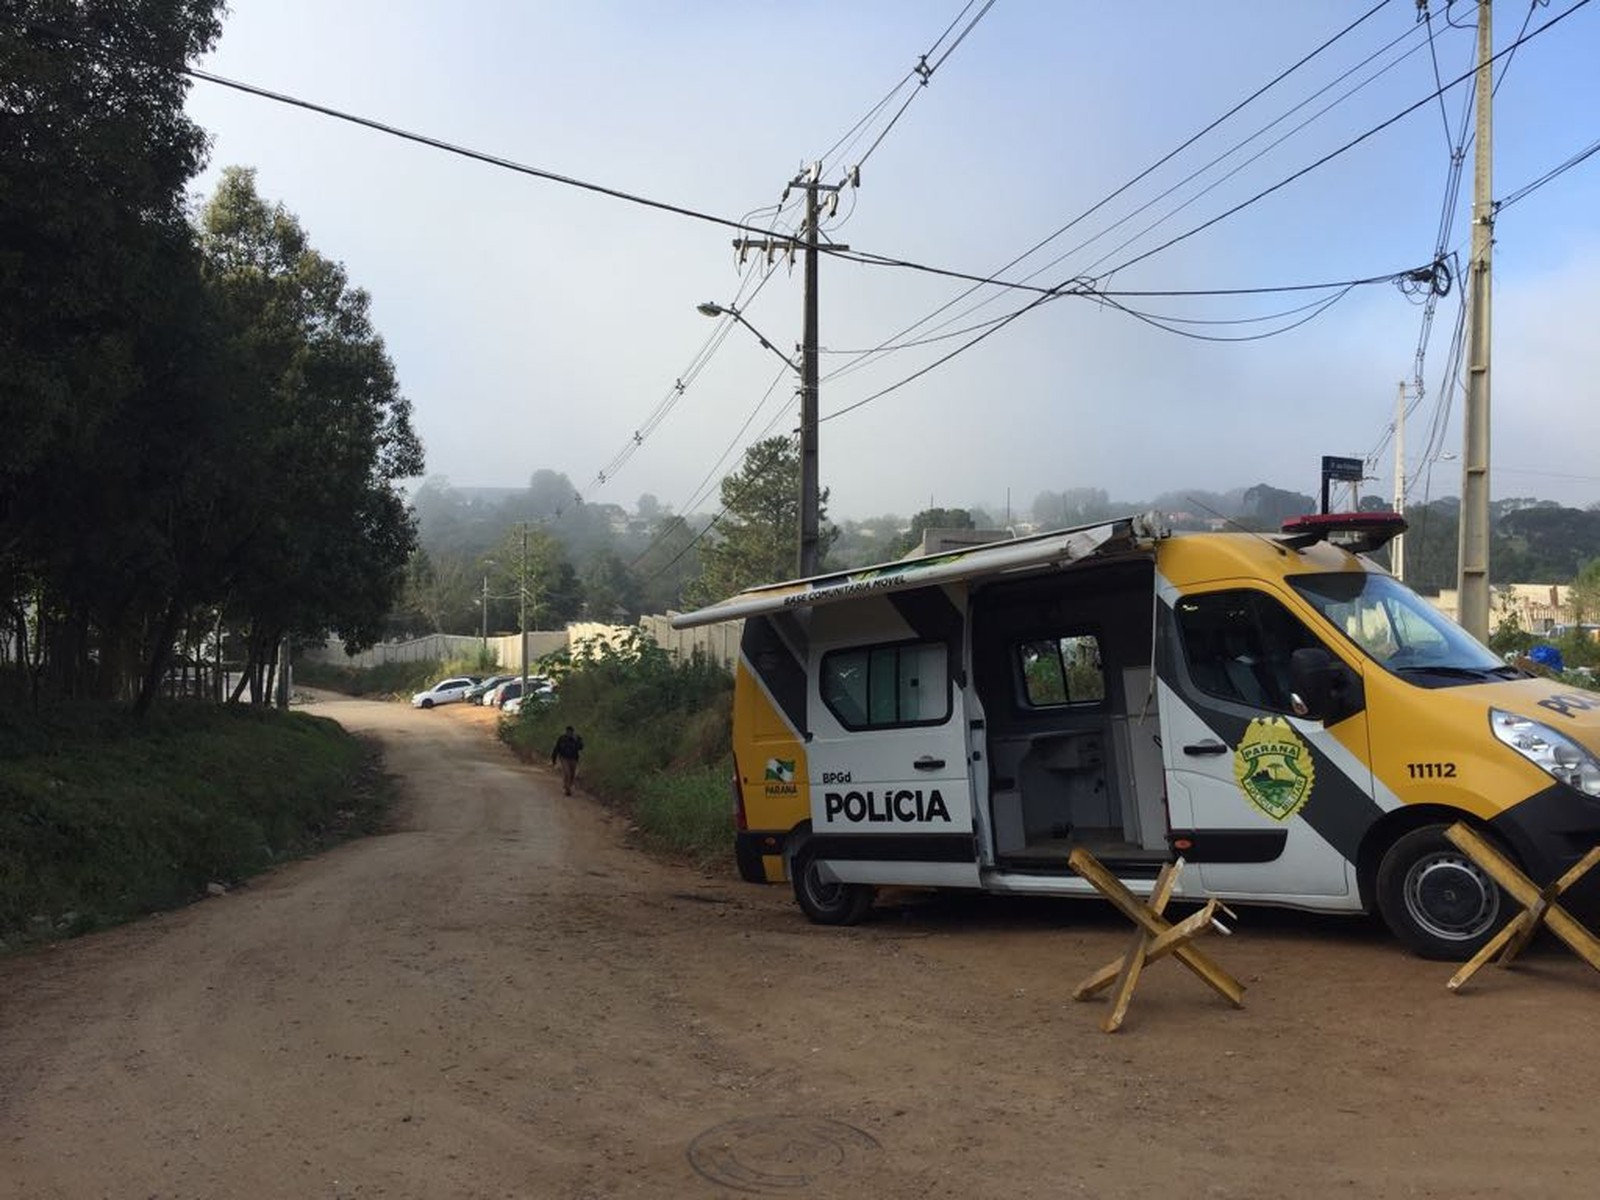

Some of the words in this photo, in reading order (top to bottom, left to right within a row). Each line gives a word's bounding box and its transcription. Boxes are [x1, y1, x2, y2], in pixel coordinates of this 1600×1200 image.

[1537, 694, 1600, 718] PO
[822, 771, 852, 784] BPGd
[1407, 762, 1457, 778] 11112
[824, 790, 951, 822] POLÍCIA
